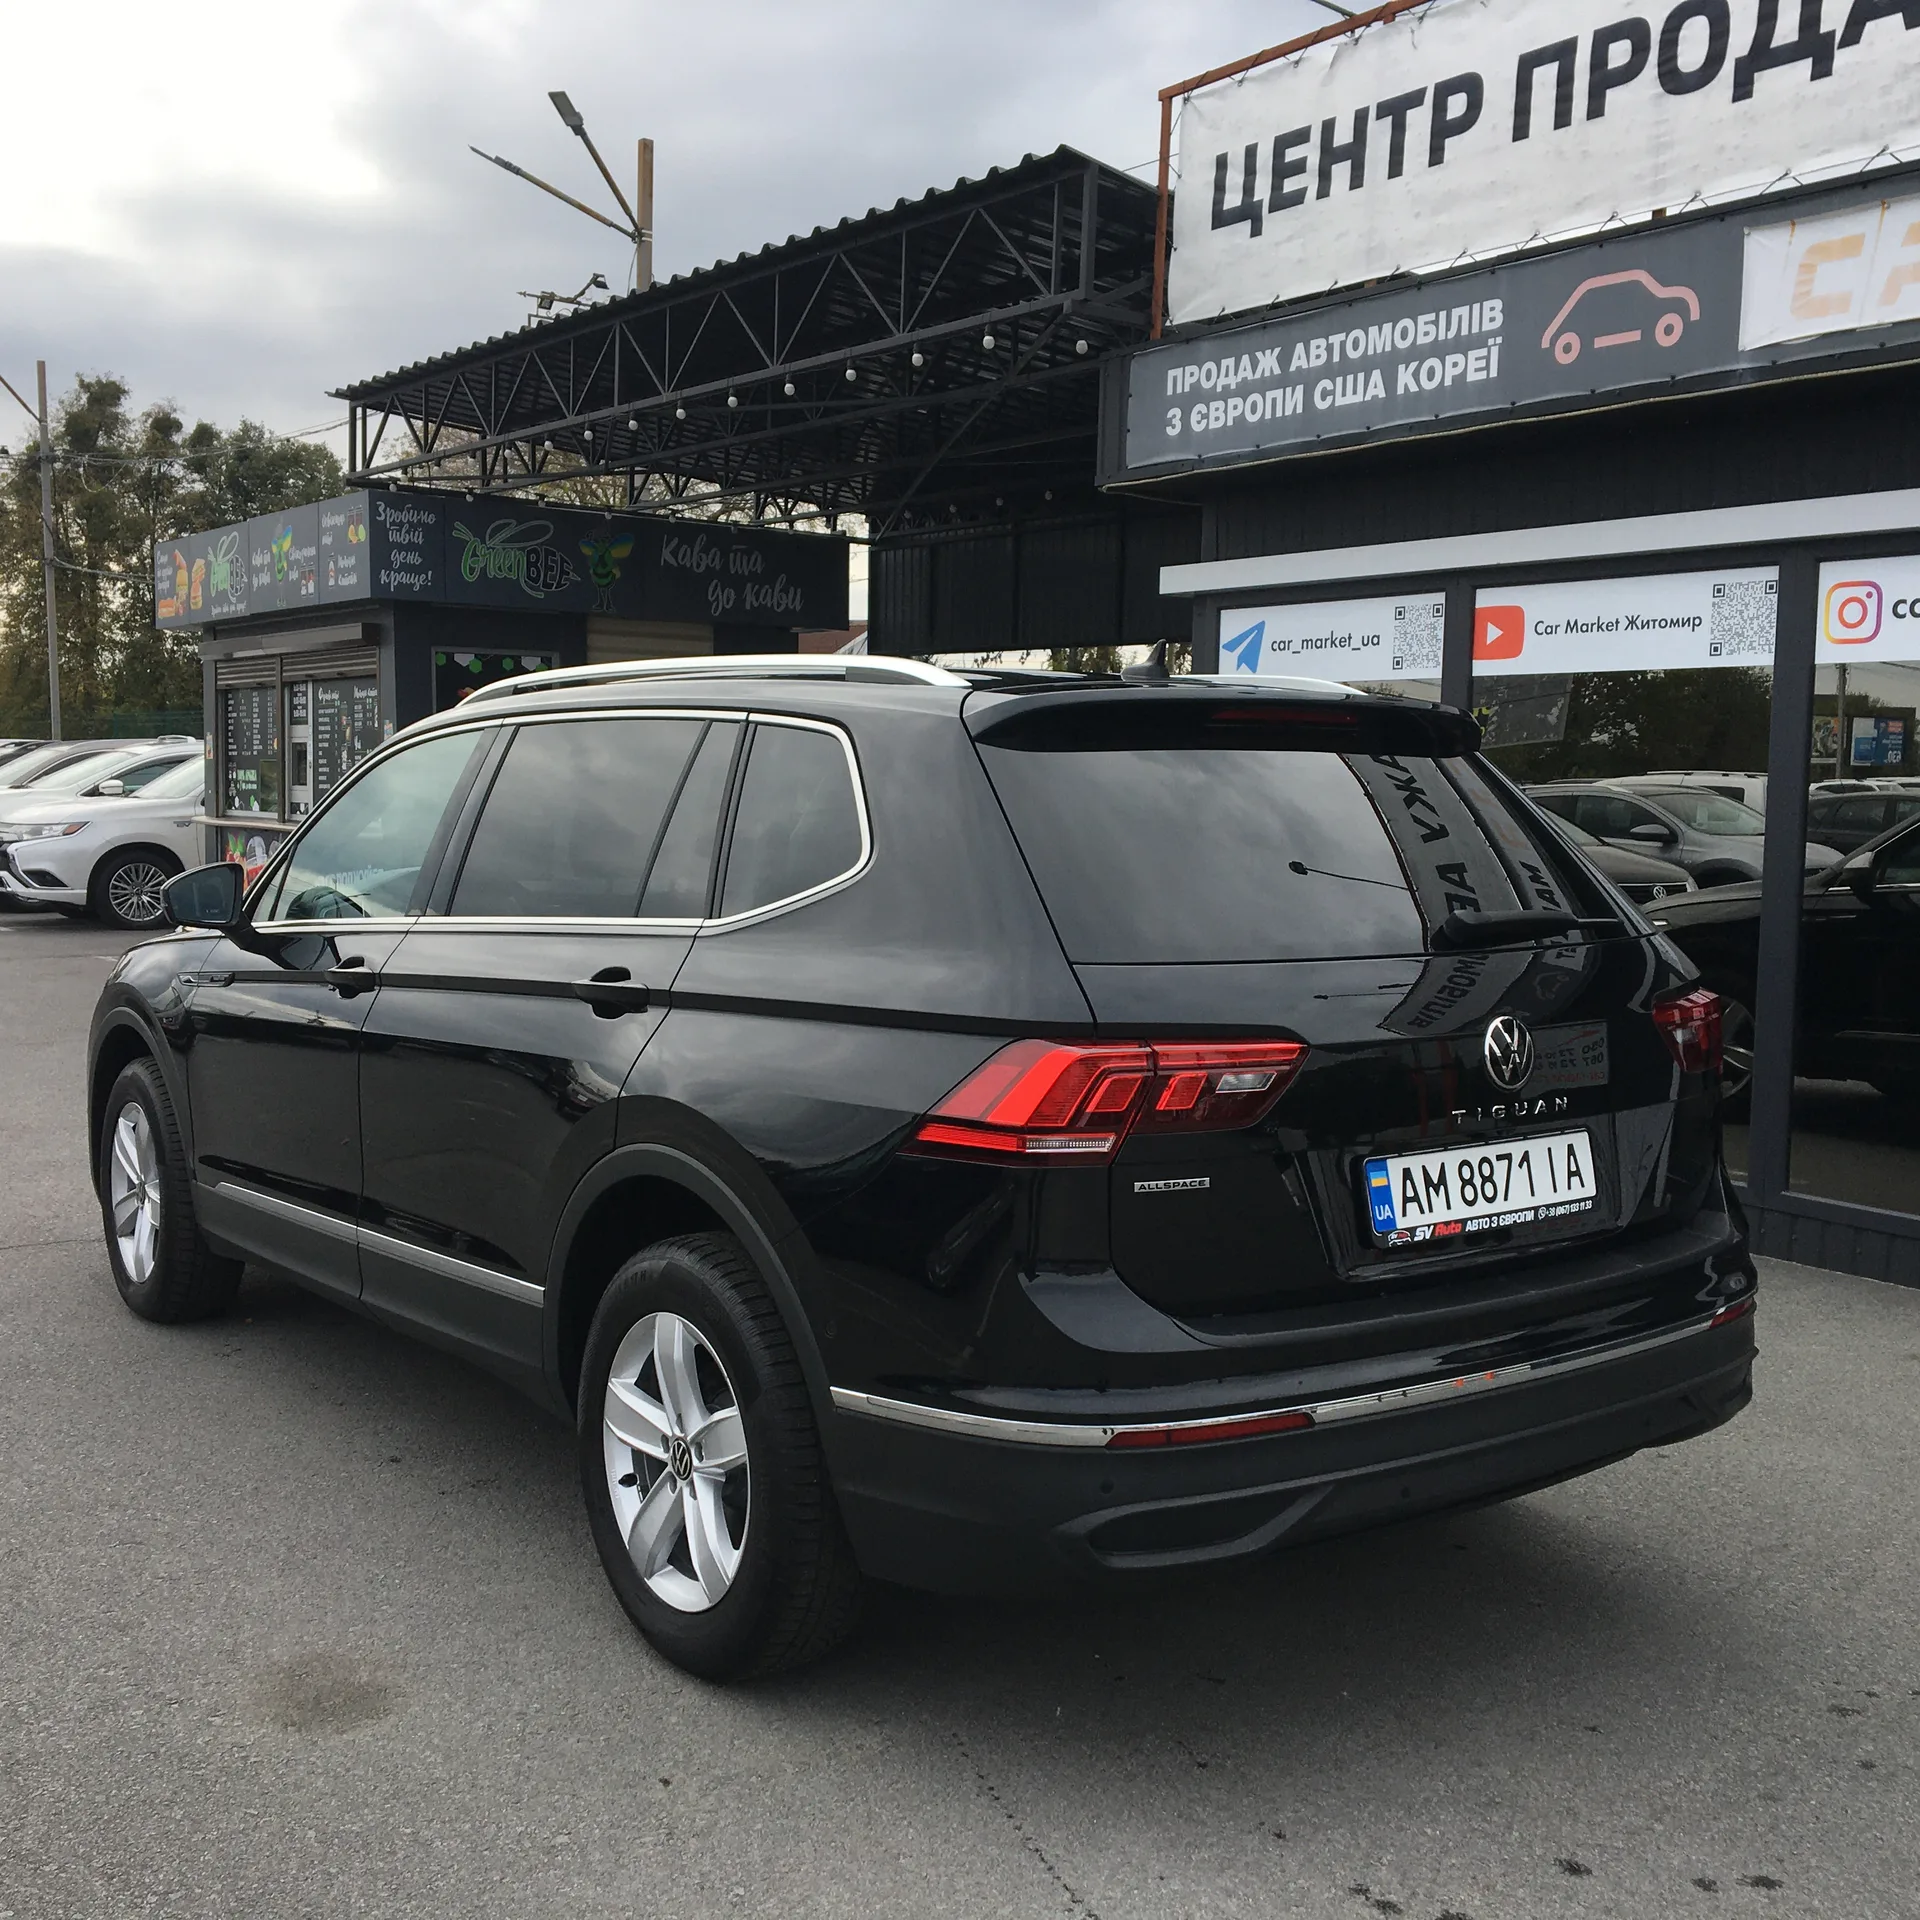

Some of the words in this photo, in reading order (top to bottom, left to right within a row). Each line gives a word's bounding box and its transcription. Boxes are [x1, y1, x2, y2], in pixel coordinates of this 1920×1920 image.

[1211, 71, 1484, 238] ЦЕНТР
[1166, 346, 1282, 396] ПРОДАЖ
[1289, 298, 1504, 371] АВТОМОБІЛІВ
[1165, 407, 1182, 436] З
[1189, 384, 1305, 432] ЄВРОПИ
[1314, 369, 1386, 410] США
[1396, 336, 1503, 395] КОРЕЇ
[376, 501, 436, 528] Зробимо
[389, 523, 424, 544] твій
[390, 549, 423, 569] день
[660, 533, 724, 573] Кава
[729, 545, 765, 575] та
[379, 569, 433, 592] краще!
[707, 579, 736, 616] до
[743, 573, 804, 612] кави
[1534, 620, 1560, 636] Car
[1564, 615, 1620, 634] Market
[1624, 614, 1703, 632] Житомир
[1271, 630, 1380, 654] car_market_ua
[1452, 1096, 1568, 1124] TIGUAN
[1138, 1180, 1206, 1191] ALLSPACE
[1402, 1162, 1451, 1217] AM
[1457, 1150, 1535, 1207] 8871
[1548, 1143, 1585, 1194] IA
[1375, 1205, 1393, 1221] UA
[1413, 1225, 1434, 1241] SV
[1435, 1222, 1462, 1236] Auto
[1465, 1216, 1490, 1232] АВТО
[1499, 1210, 1535, 1226] ЄВРОПИ
